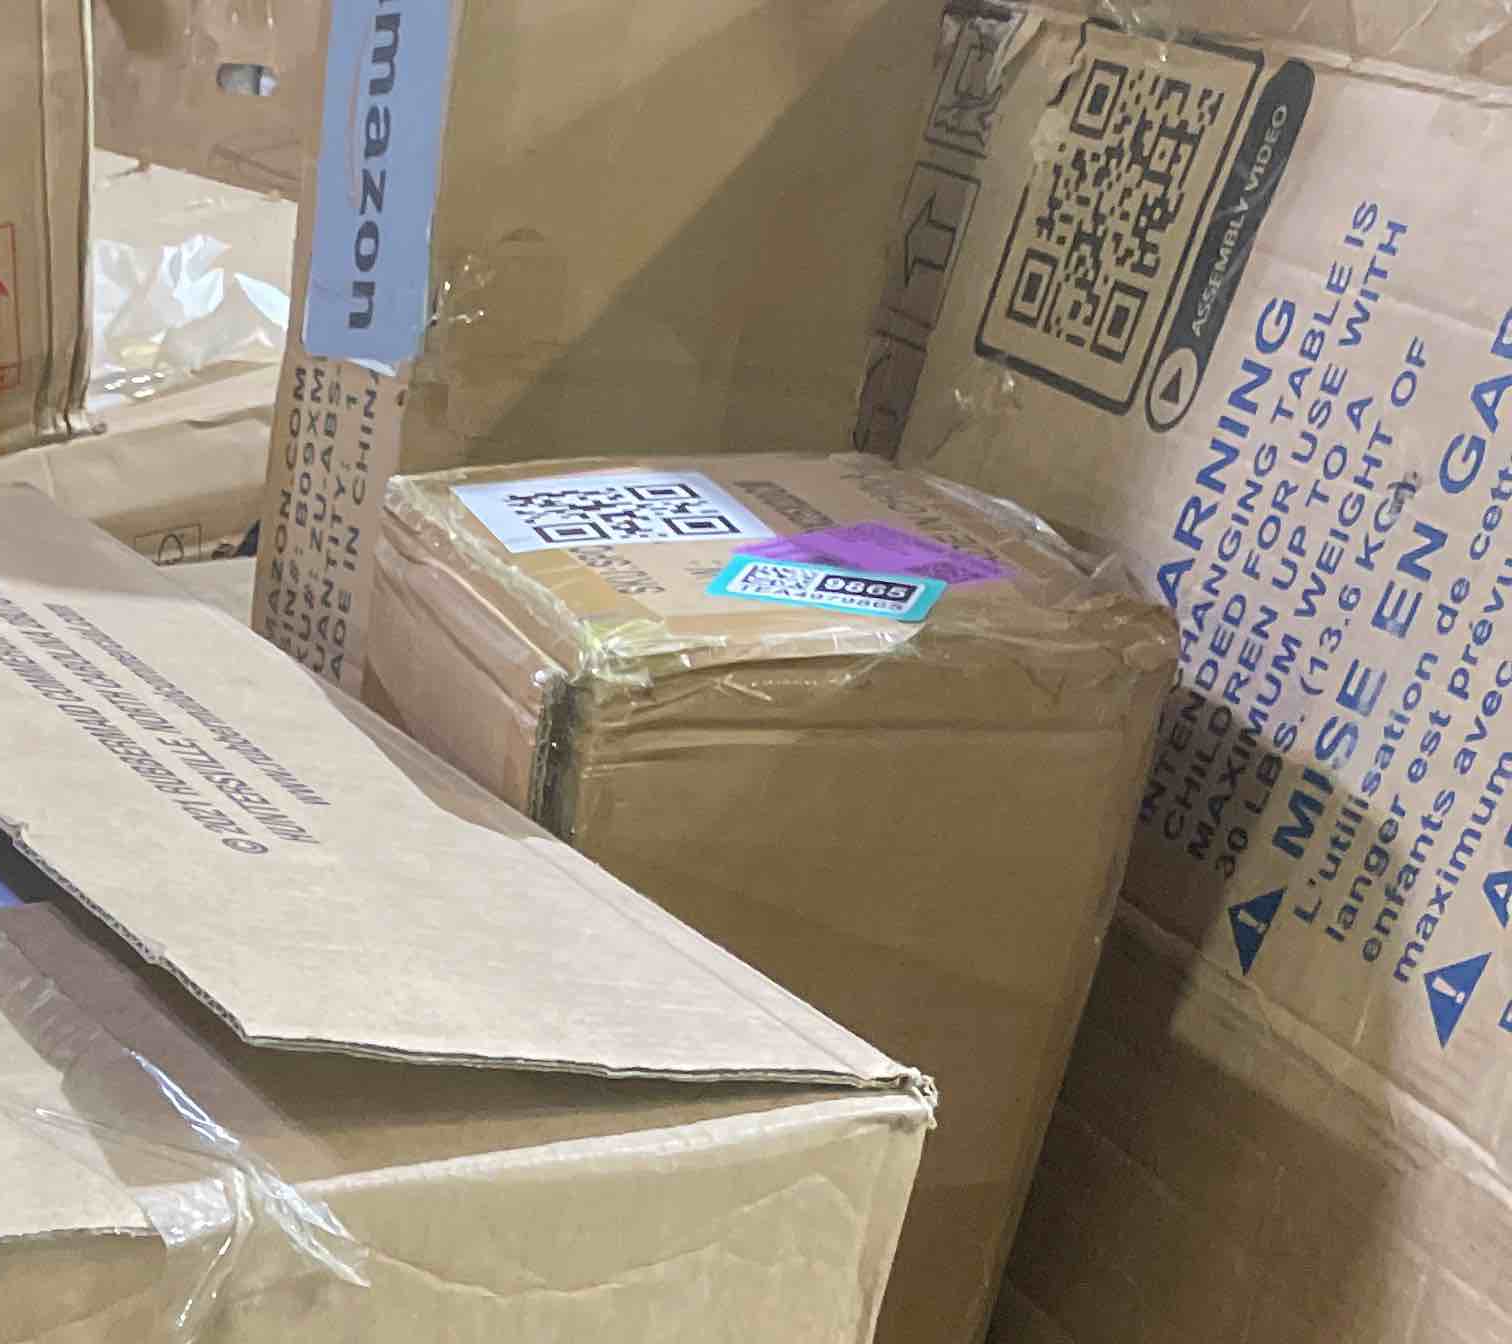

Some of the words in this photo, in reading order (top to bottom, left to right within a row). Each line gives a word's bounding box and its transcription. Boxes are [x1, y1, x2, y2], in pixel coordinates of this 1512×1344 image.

[347, 0, 402, 330] mazon
[1191, 196, 1251, 337] ASSEMBLY
[1246, 104, 1289, 192] VIDEO
[1242, 479, 1299, 581] FOR
[1291, 363, 1348, 464] USE
[1339, 221, 1407, 346] WITH
[1270, 263, 1353, 423] TABLE
[1343, 201, 1378, 248] IS
[1148, 299, 1295, 609] ARNING
[19, 625, 128, 694] CAROLINA
[824, 577, 909, 598] 9865
[1161, 608, 1276, 842] CHILDREN
[1271, 525, 1307, 591] UP
[1305, 444, 1348, 507] TO
[1346, 396, 1374, 433] A
[1184, 636, 1299, 868] MAXIMUM
[1294, 422, 1393, 618] WEIGHT
[1390, 336, 1426, 408] OF
[1270, 662, 1385, 864] MISE
[1371, 522, 1448, 638] EN
[1290, 654, 1436, 933] L'utilisation
[1436, 577, 1471, 636] de
[1469, 467, 1512, 561] cett
[1299, 584, 1361, 696] (13.6
[60, 703, 196, 809] RUBBERMAID
[104, 689, 188, 746] NORTH
[161, 736, 321, 845] HUNTERSVILLE,
[184, 801, 245, 843] 2021
[1324, 796, 1405, 943] langer
[1407, 710, 1452, 784] est
[1355, 791, 1455, 969] enfants
